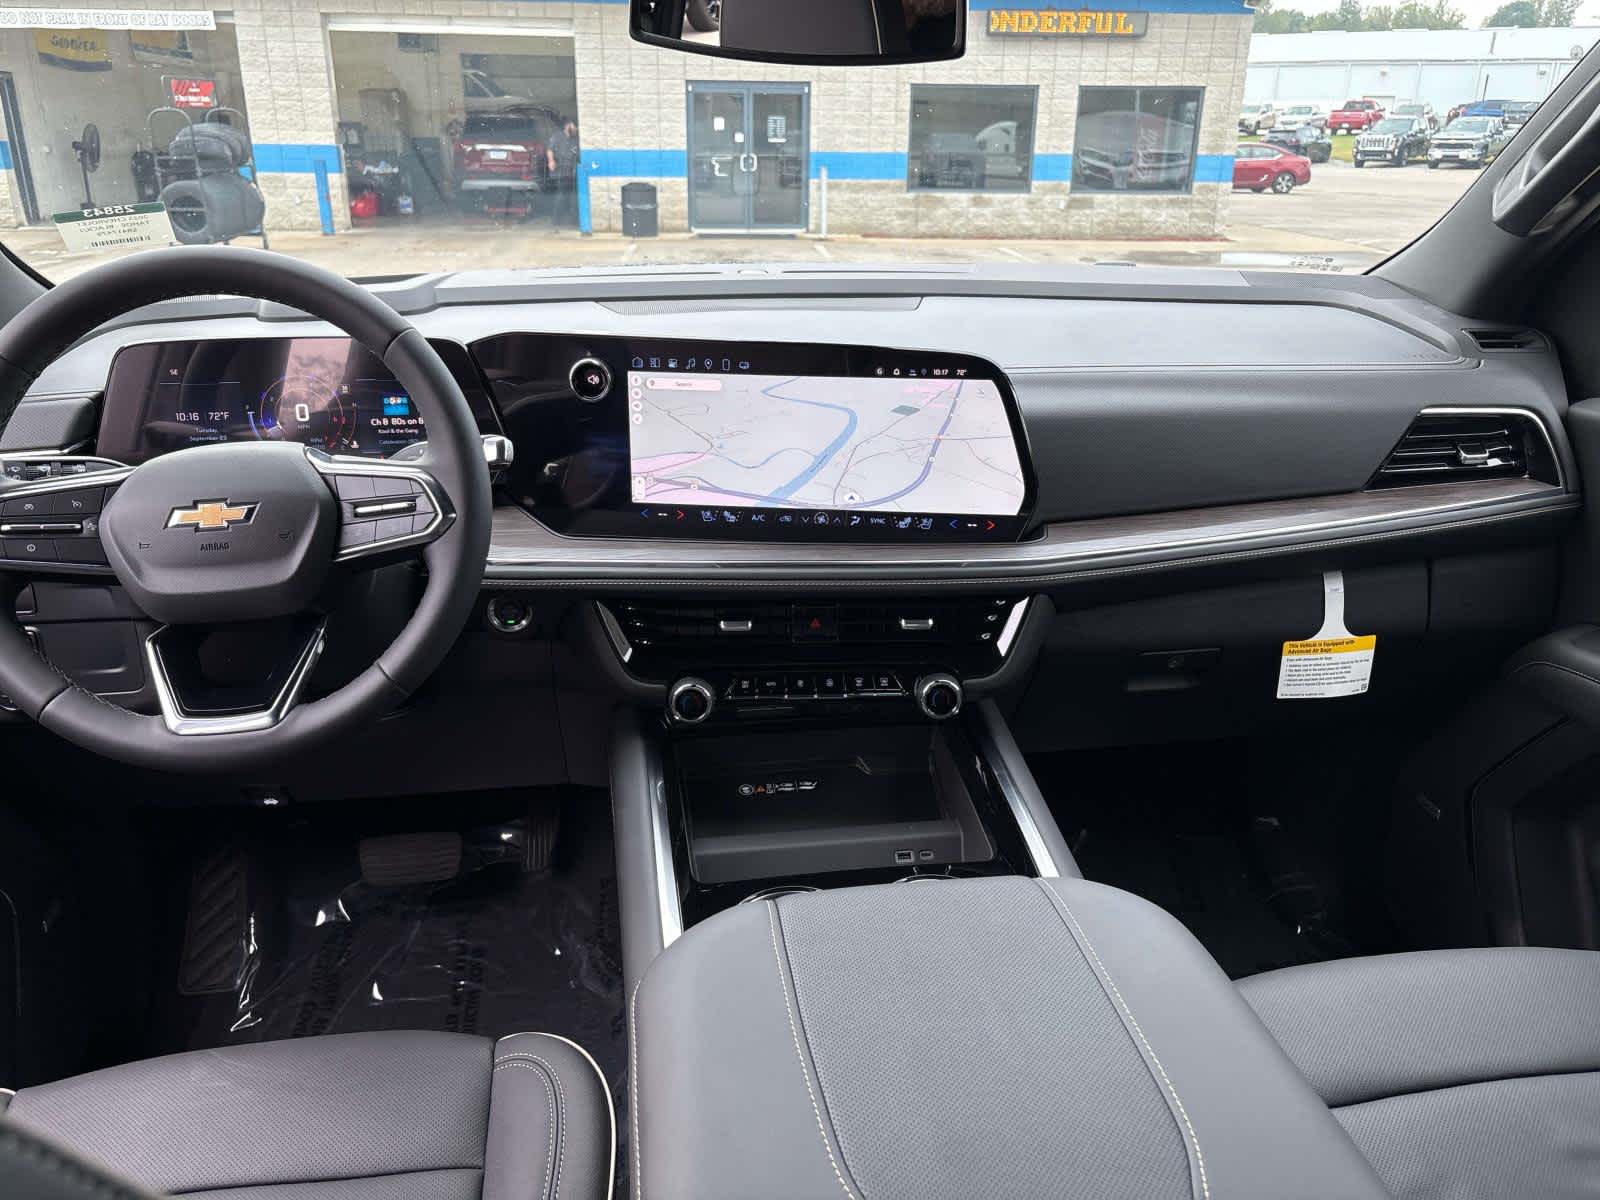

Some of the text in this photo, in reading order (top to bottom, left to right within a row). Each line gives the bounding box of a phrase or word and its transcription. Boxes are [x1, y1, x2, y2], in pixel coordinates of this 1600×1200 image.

[19, 11, 43, 24] NOT
[47, 12, 76, 24] PARK
[78, 12, 89, 24] IN
[95, 13, 128, 25] FRONT
[131, 13, 145, 25] OF
[149, 14, 169, 26] BAY
[175, 14, 210, 26] DOORS
[933, 368, 949, 376] 10:17
[175, 411, 230, 422] 10:16 72°F
[295, 403, 310, 422] 0
[370, 418, 381, 426] Ch
[391, 417, 406, 426] 80s
[407, 418, 418, 426] on
[751, 514, 765, 522] A/C
[869, 517, 887, 525] SYNC
[200, 542, 230, 552] AIRBAG
